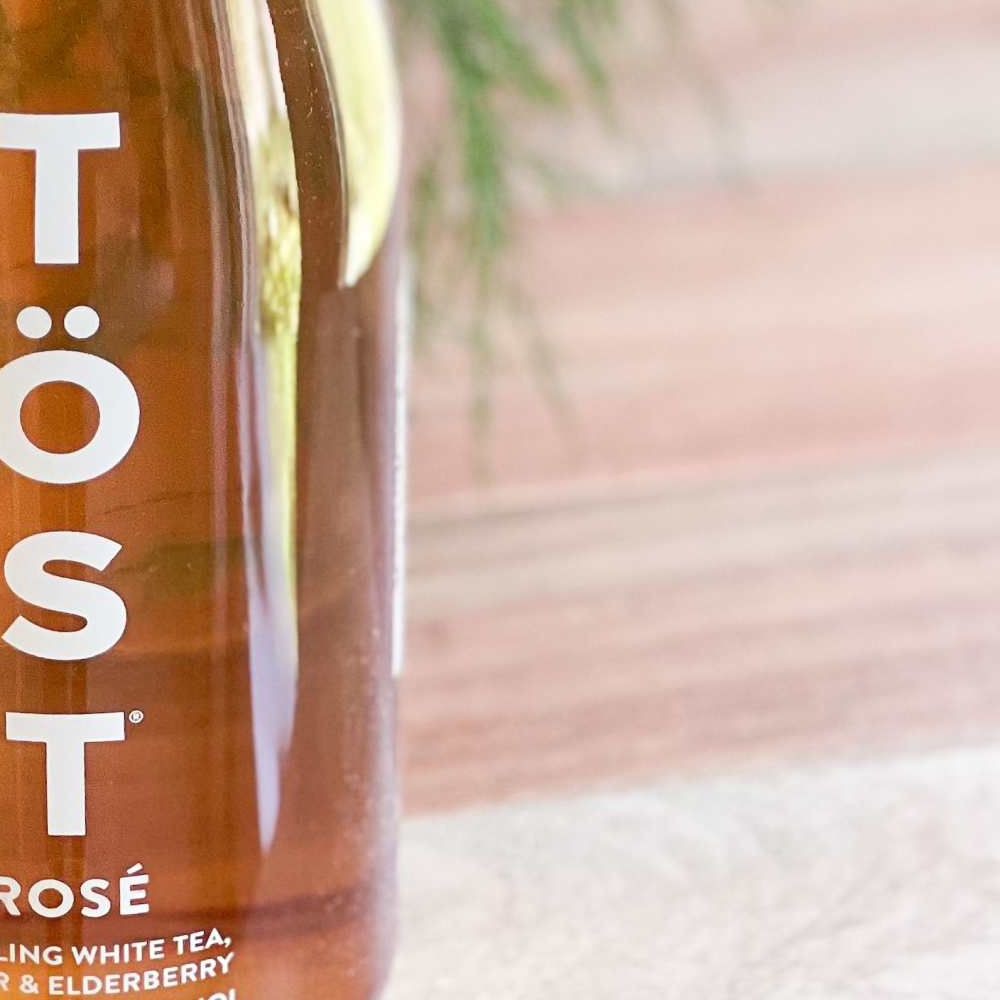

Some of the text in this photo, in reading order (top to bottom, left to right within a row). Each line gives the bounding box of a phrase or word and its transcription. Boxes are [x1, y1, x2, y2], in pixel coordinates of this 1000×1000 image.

[71, 938, 165, 966] WHITE
[173, 927, 232, 956] TEA,
[19, 974, 40, 995] &
[48, 951, 234, 996] ELDERBERRY
